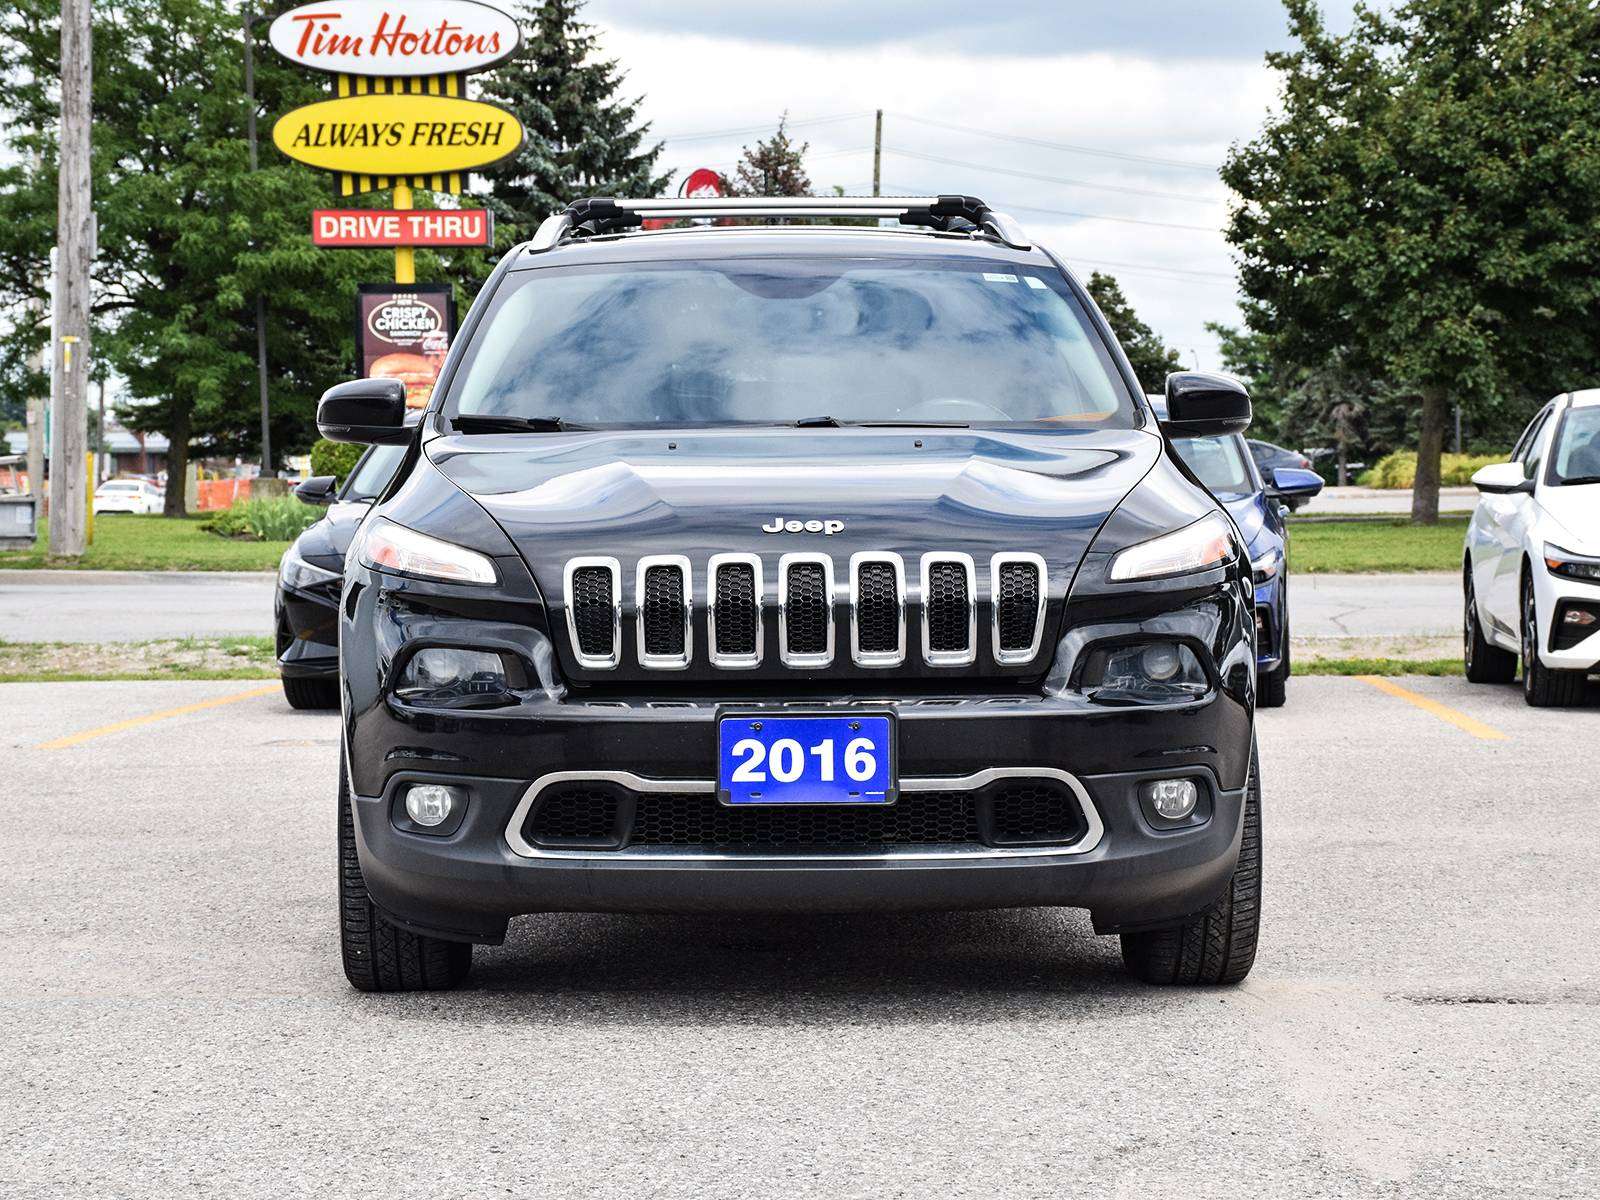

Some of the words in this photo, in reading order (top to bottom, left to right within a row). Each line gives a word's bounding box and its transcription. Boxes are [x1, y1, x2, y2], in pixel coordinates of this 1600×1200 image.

[292, 13, 363, 57] Tim
[369, 11, 500, 57] Hortons
[292, 121, 404, 147] ALWAYS
[409, 121, 505, 147] FRESH
[319, 216, 400, 239] DRIVE
[407, 216, 481, 238] THRU
[375, 318, 436, 330] CHICKEN
[381, 307, 429, 319] CRISPY
[762, 517, 845, 536] Jeep
[731, 737, 877, 783] 2016
